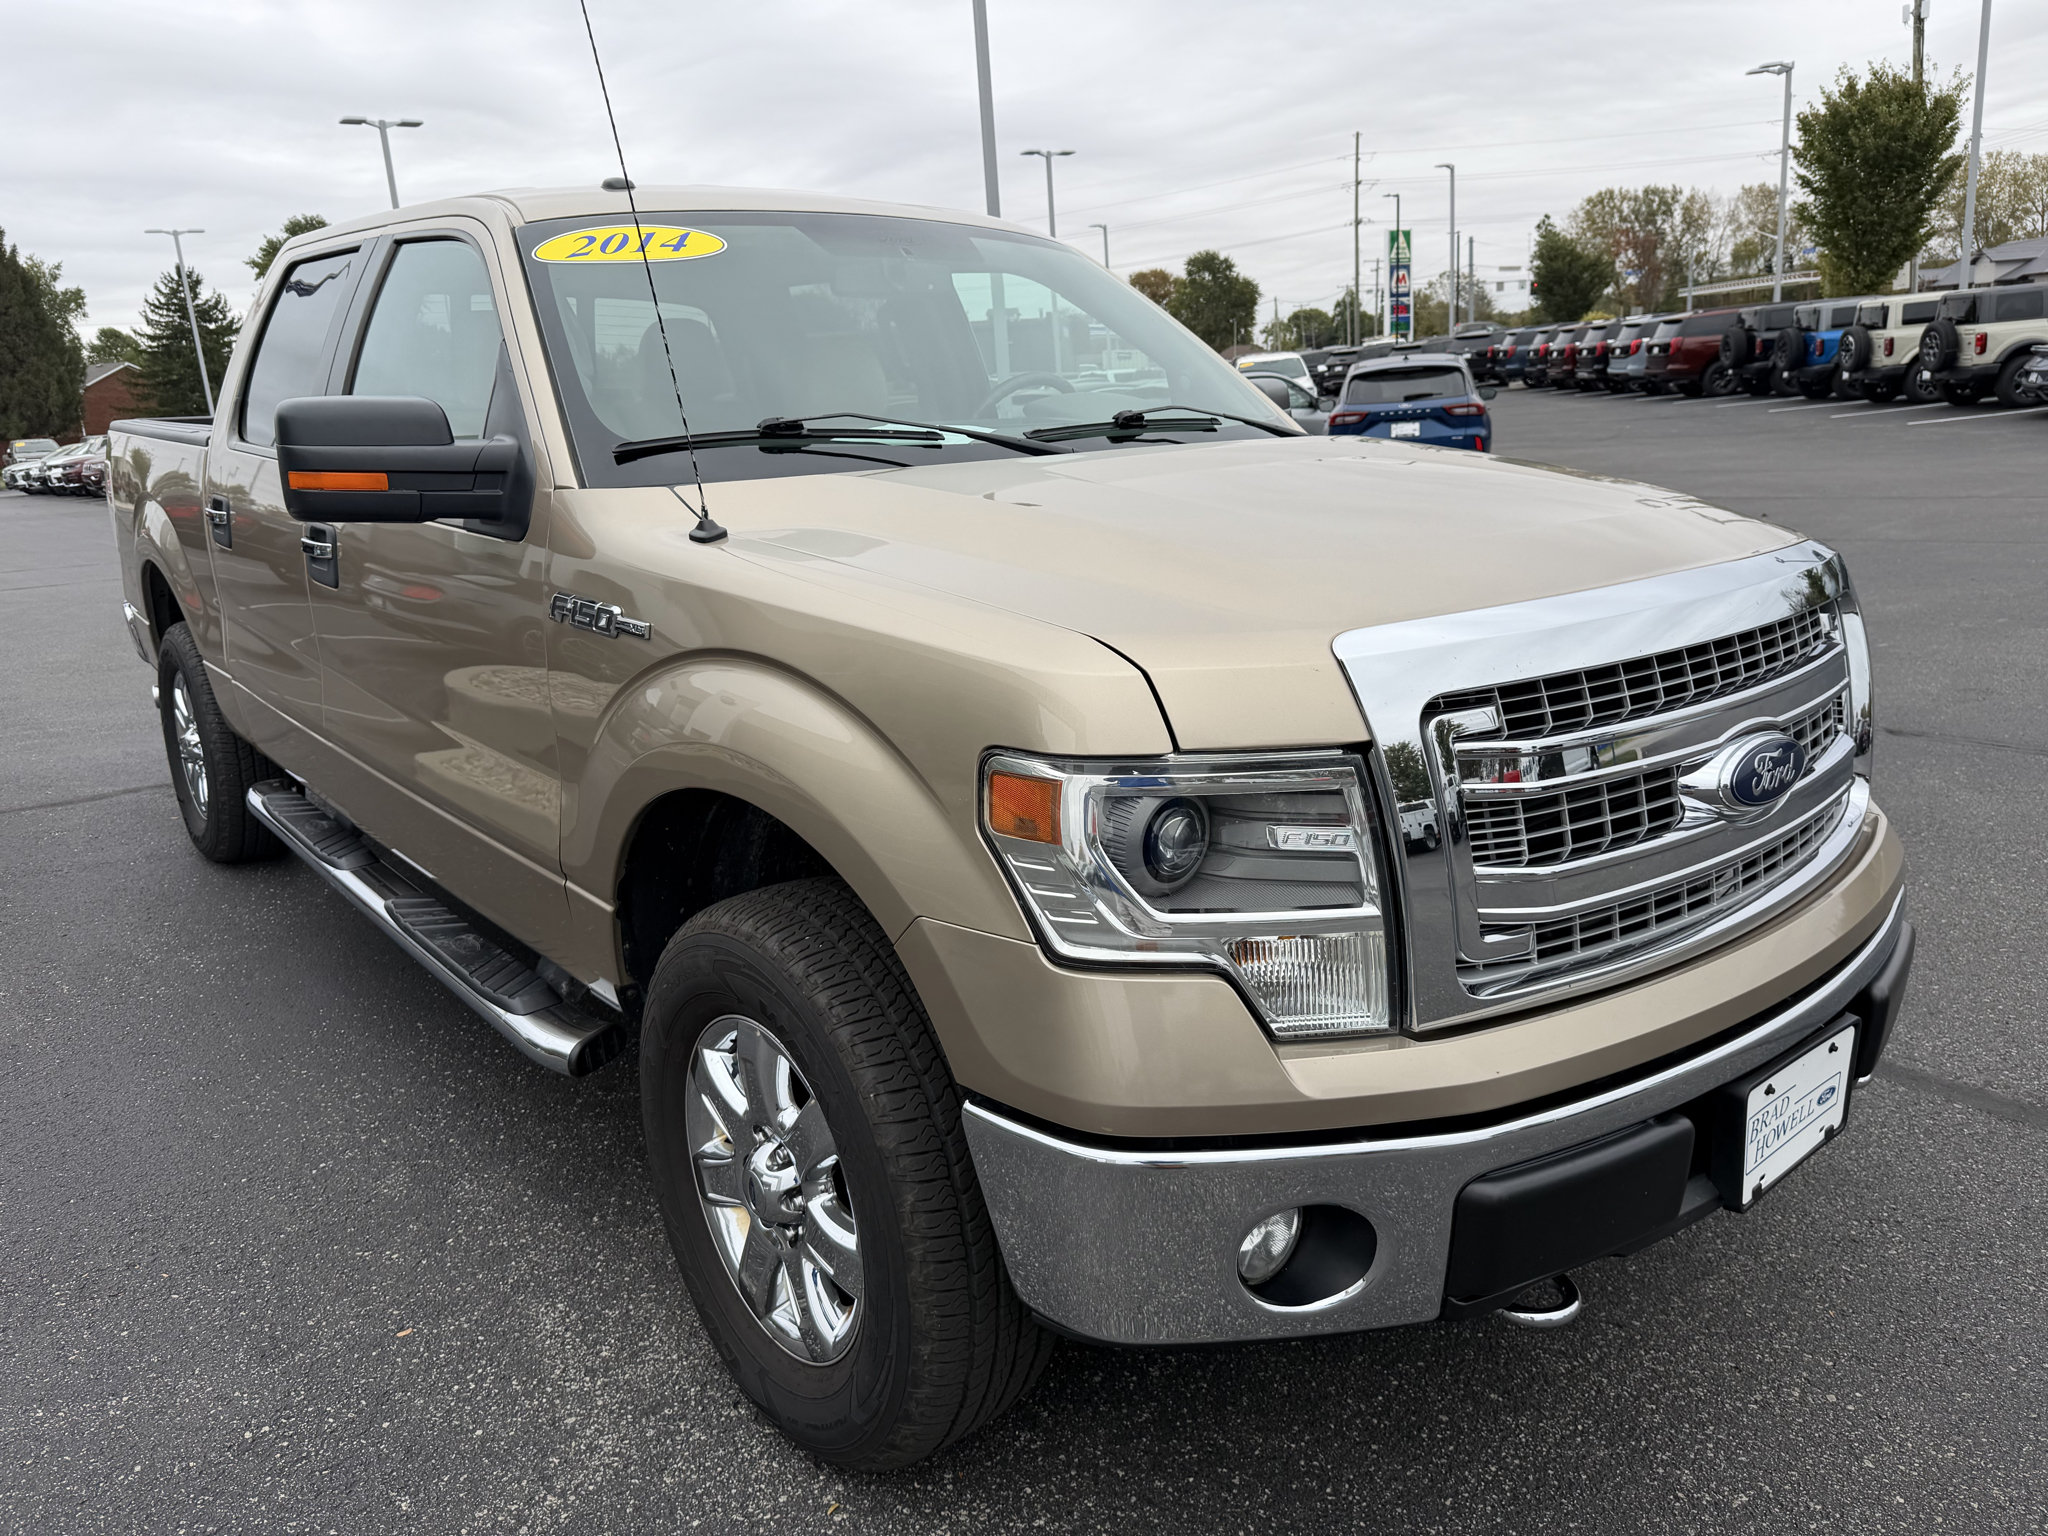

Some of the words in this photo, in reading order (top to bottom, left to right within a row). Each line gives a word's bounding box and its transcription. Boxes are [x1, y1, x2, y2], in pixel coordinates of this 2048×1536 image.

[565, 232, 690, 258] 2014
[1753, 748, 1796, 796] Ford
[1749, 1096, 1790, 1144] BRAD
[1754, 1098, 1815, 1165] HOWELL
